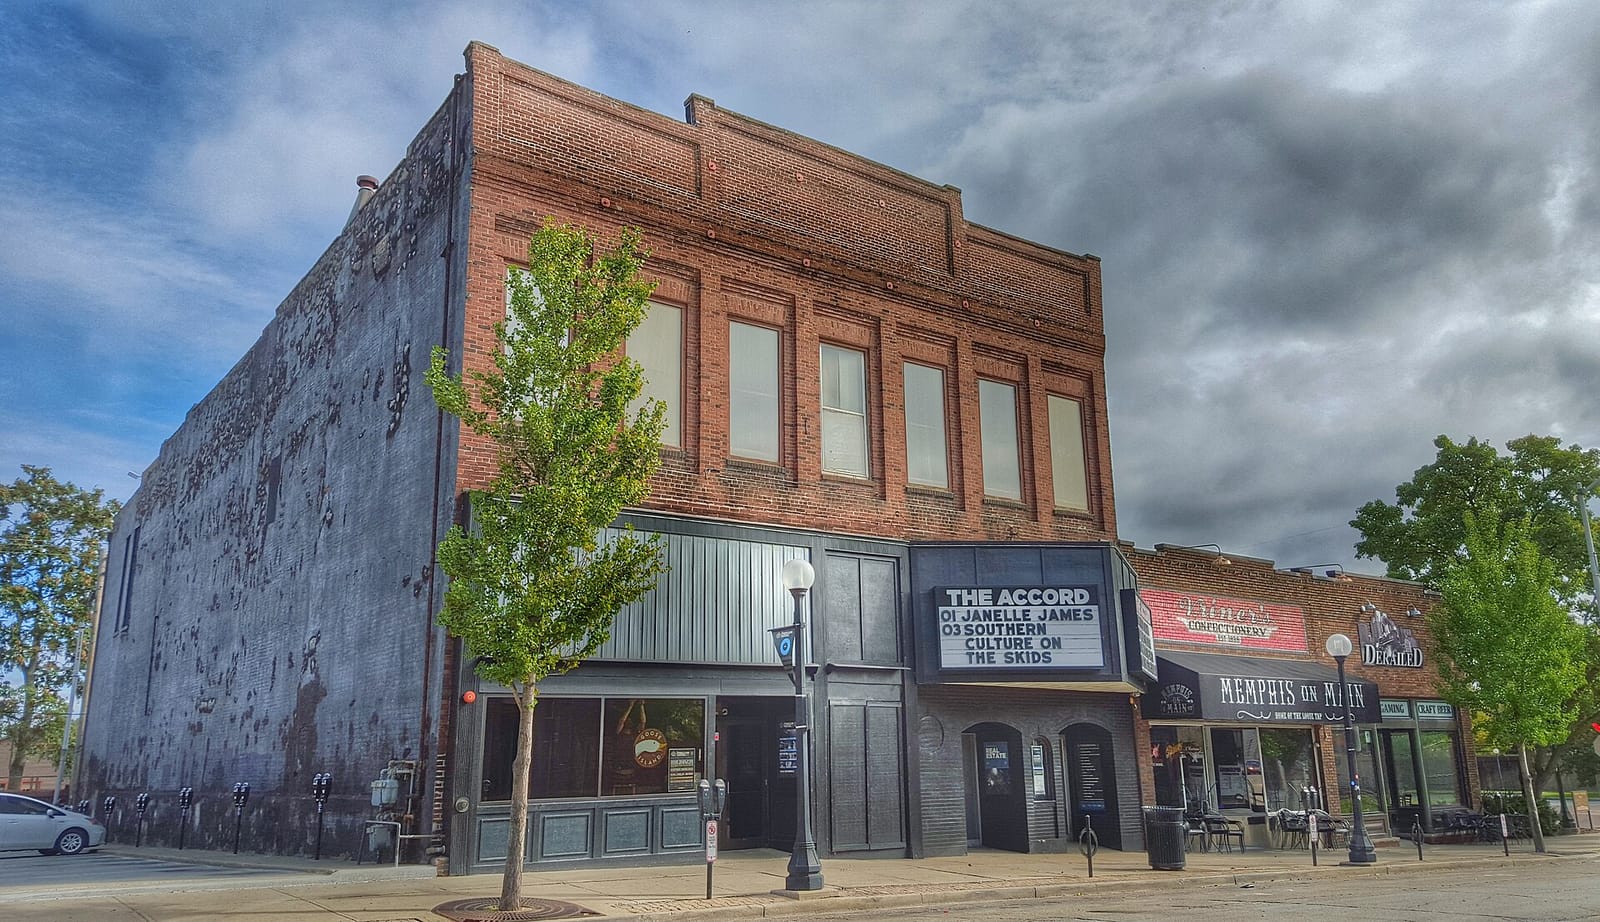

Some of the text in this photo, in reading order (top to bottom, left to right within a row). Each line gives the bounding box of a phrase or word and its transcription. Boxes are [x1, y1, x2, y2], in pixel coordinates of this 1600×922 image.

[946, 588, 1090, 606] THE ACCORD
[941, 608, 1093, 622] 01 JANELLE JAMES
[942, 623, 1047, 636] 03 SOUTHERN
[1188, 620, 1267, 637] CONFECTIONERY
[965, 636, 1062, 650] CULTURE ON
[965, 651, 1052, 665] THE SKIDS
[1160, 683, 1193, 701] MEMPHIS
[1220, 677, 1296, 706] MEMPHIS
[1301, 685, 1318, 702] ON
[1167, 703, 1187, 713] MAIN
[1418, 704, 1437, 714] CRAFT
[641, 731, 661, 739] GOOSE
[638, 755, 661, 765] ISLAND
